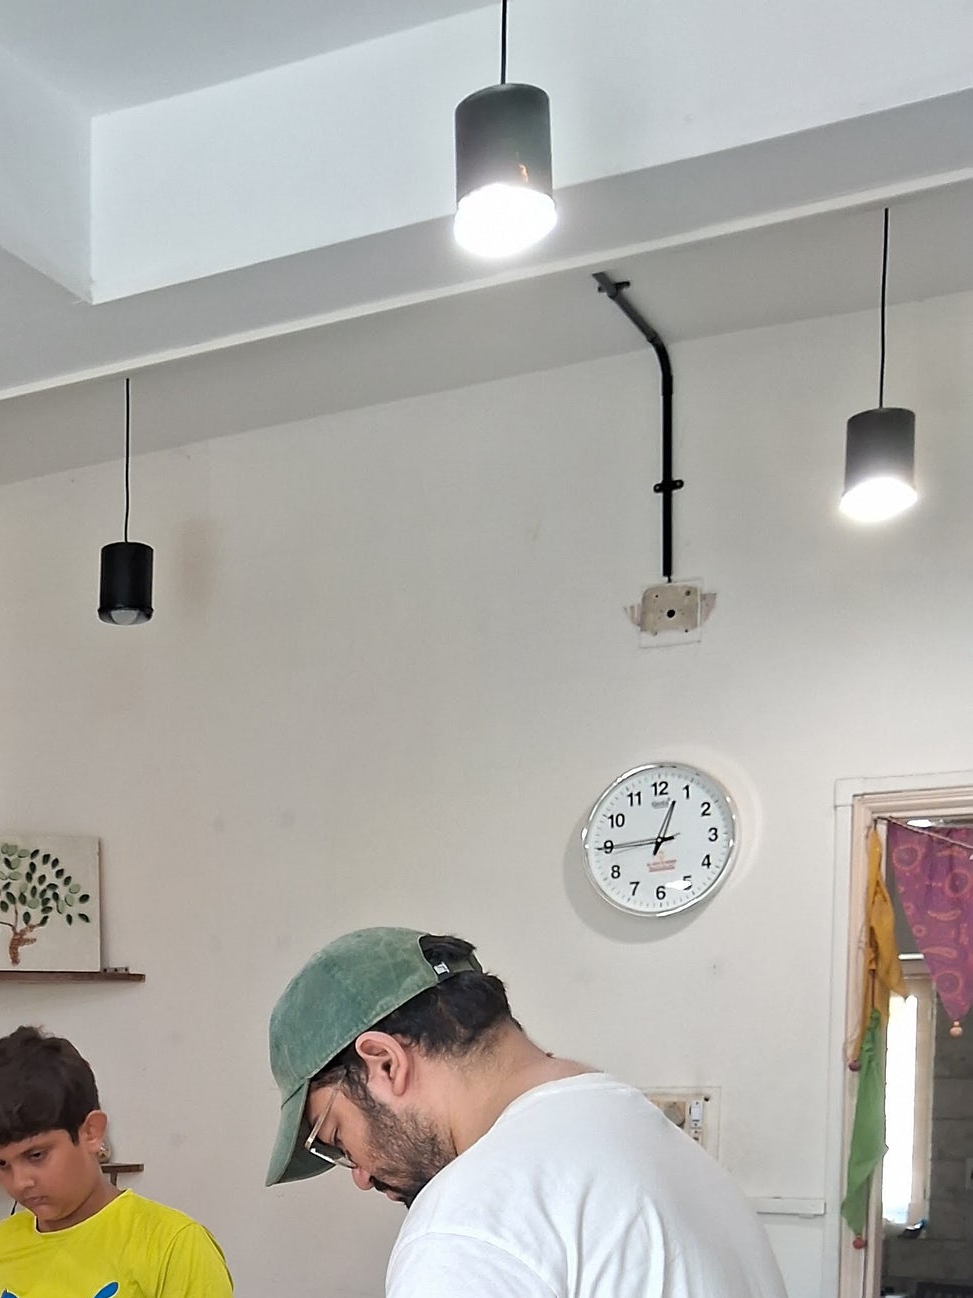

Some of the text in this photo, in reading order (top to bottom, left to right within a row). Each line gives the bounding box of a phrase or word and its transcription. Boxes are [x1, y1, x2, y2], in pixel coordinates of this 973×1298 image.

[651, 781, 669, 796] 12
[682, 784, 690, 799] 1
[627, 791, 642, 807] 11
[701, 802, 711, 817] 2
[608, 813, 625, 829] 10
[708, 827, 718, 842] 3
[604, 840, 614, 854] 9
[701, 854, 711, 869] 4
[611, 865, 621, 879] 8
[629, 881, 640, 896] 7
[655, 886, 666, 900] 6
